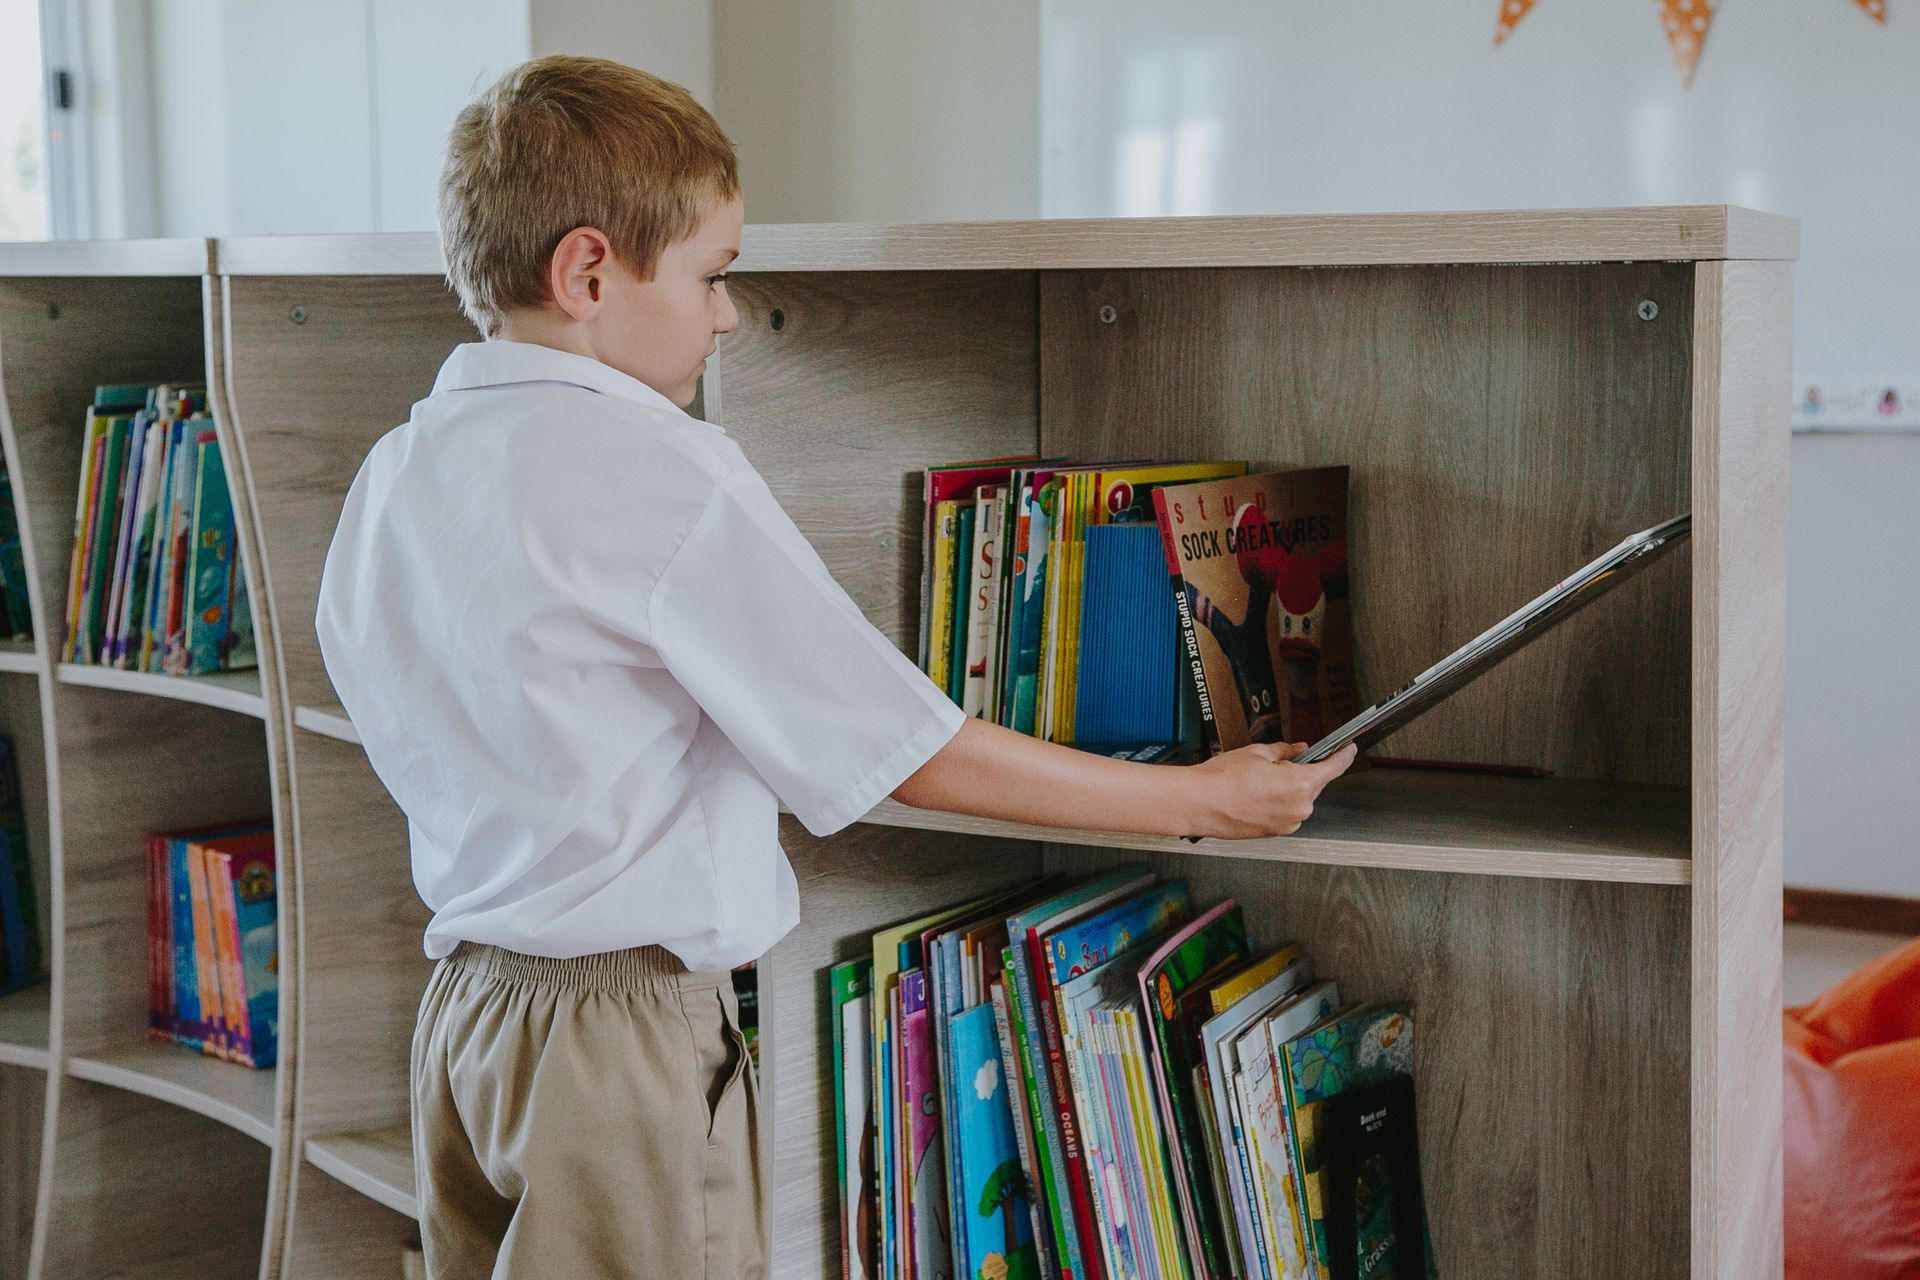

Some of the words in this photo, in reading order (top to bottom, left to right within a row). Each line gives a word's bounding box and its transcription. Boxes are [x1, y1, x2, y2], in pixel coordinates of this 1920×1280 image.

[1181, 528, 1222, 562] SOCK
[1226, 515, 1330, 555] CREATURES
[1175, 591, 1192, 627] STUPID
[1184, 630, 1199, 659] SOCK
[1191, 660, 1213, 721] CREATURES
[1061, 1112, 1078, 1159] OCEANS
